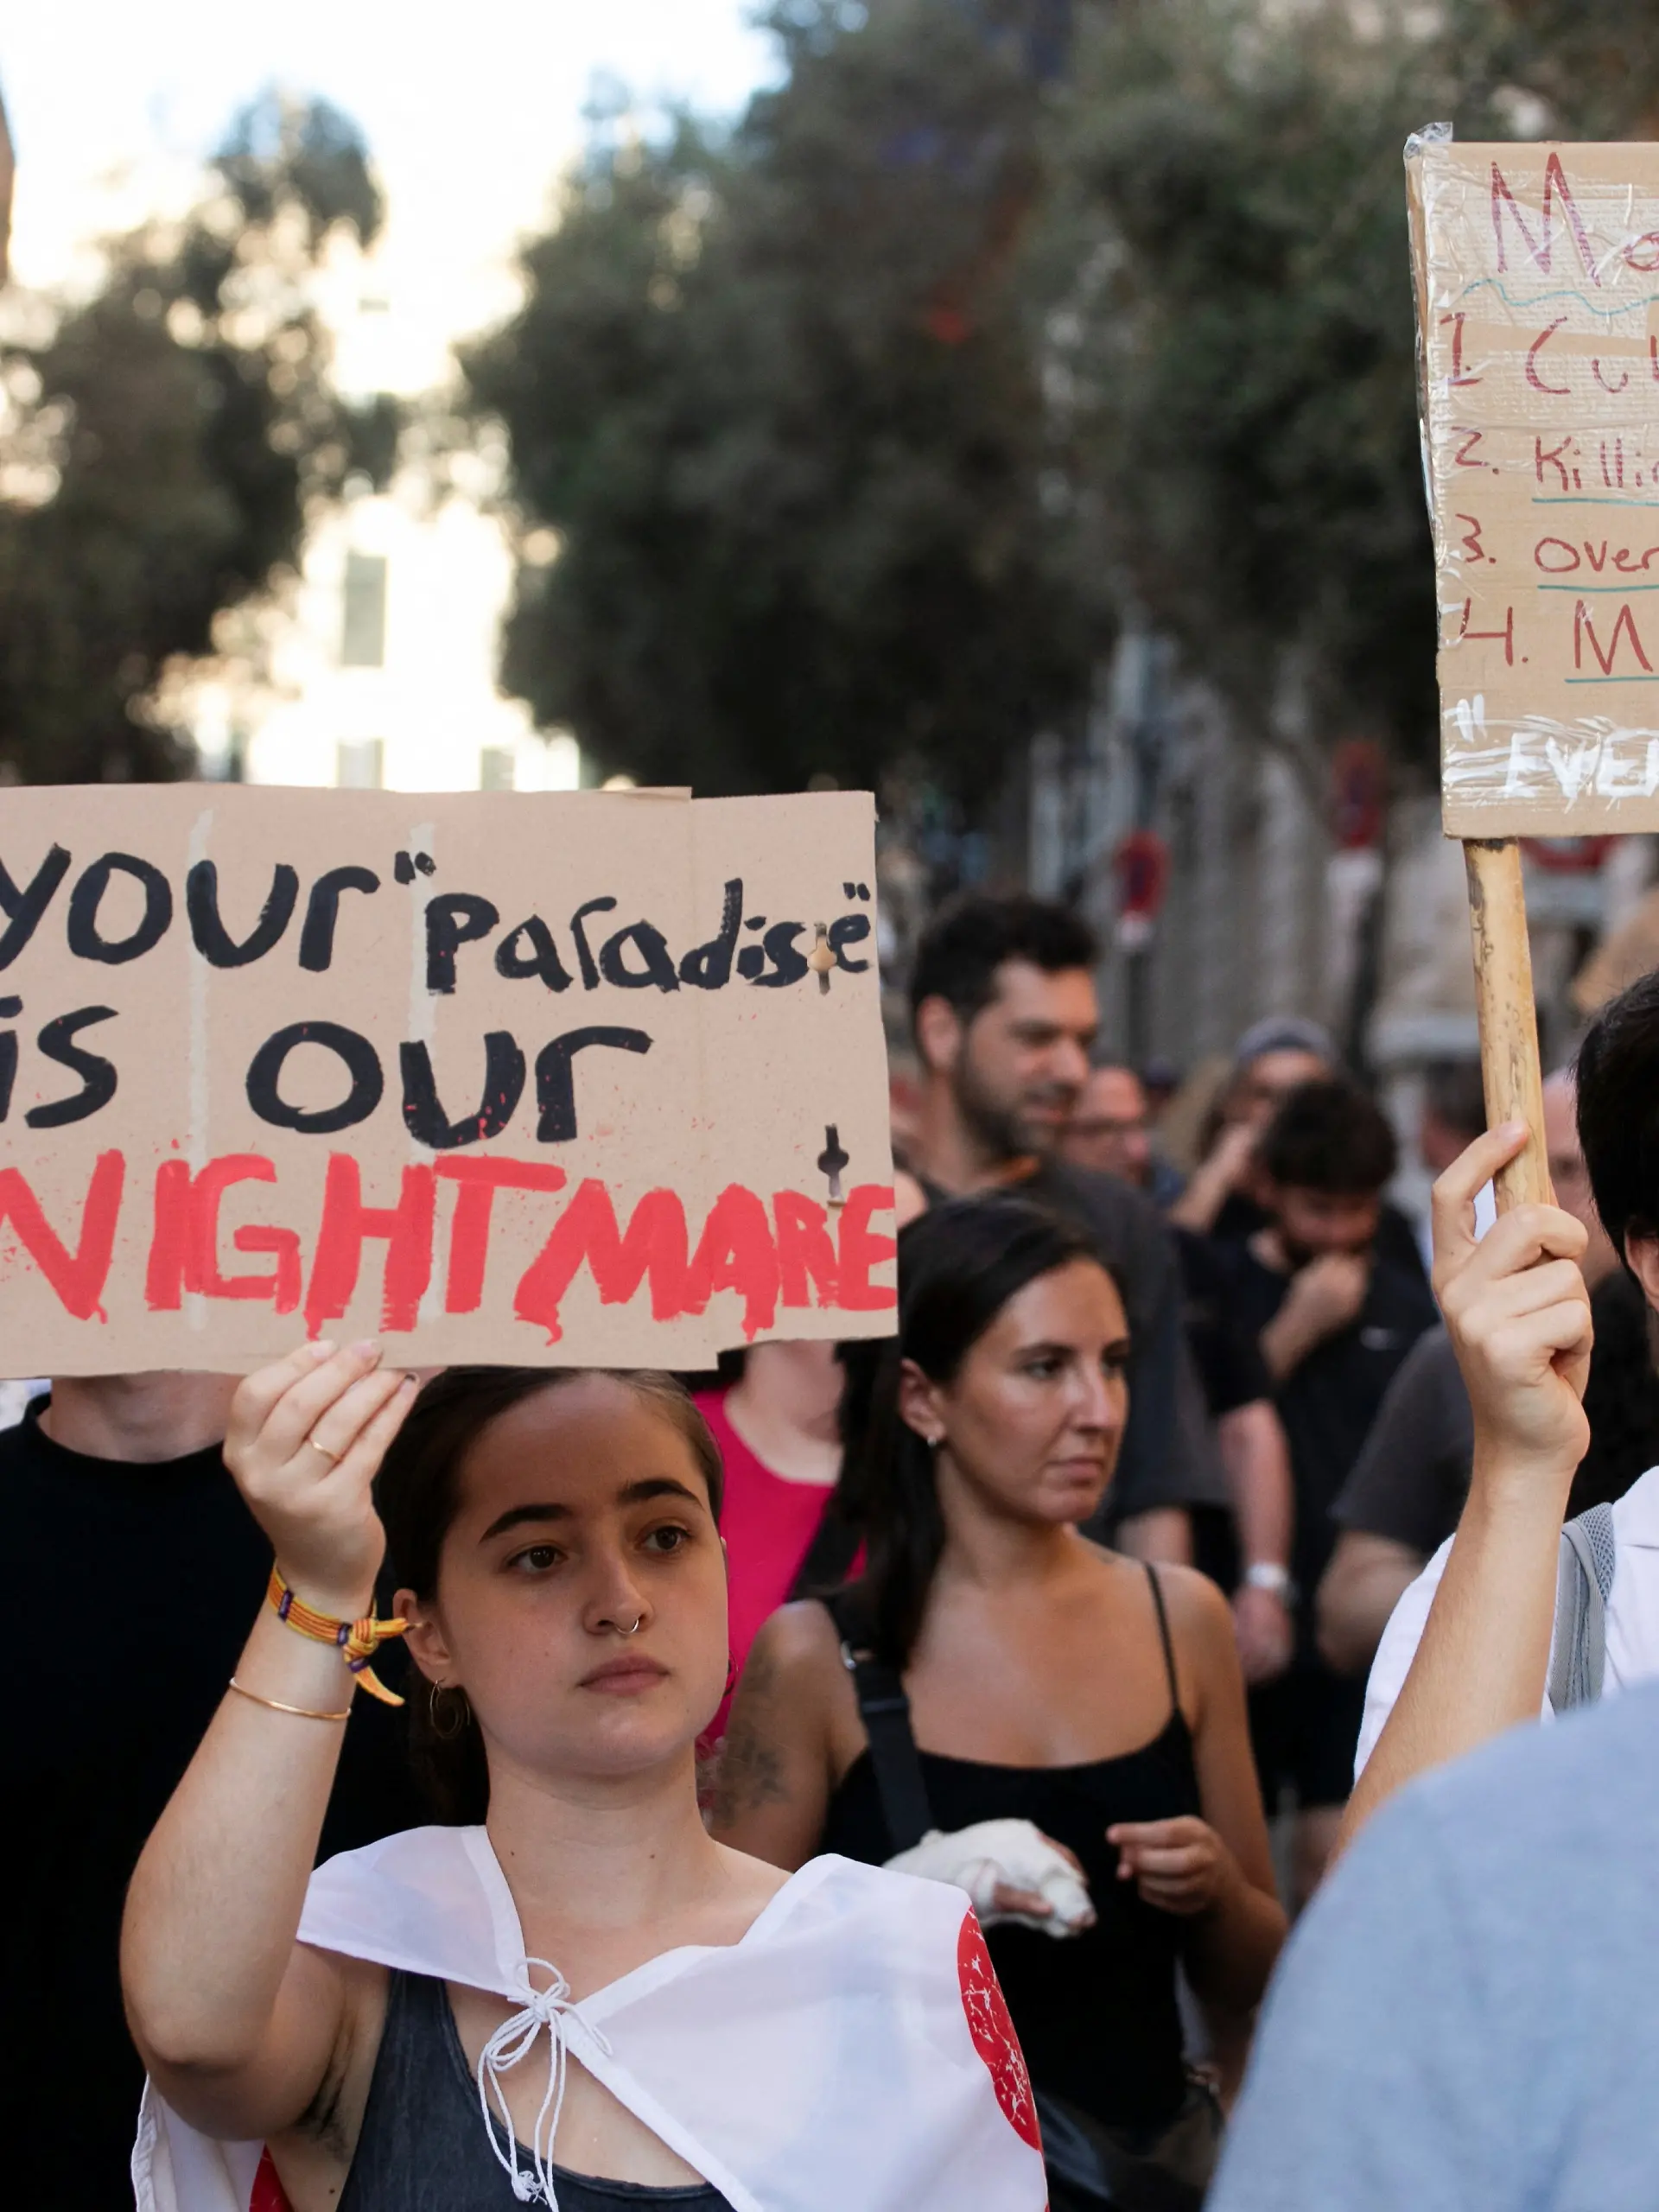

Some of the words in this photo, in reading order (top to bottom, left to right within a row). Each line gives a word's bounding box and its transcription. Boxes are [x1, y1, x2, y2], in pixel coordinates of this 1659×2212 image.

[1440, 312, 1484, 386] 1.
[1451, 425, 1500, 475] 2.
[1455, 513, 1497, 564] 3.
[0, 1147, 897, 1344] NIGHTMARE
